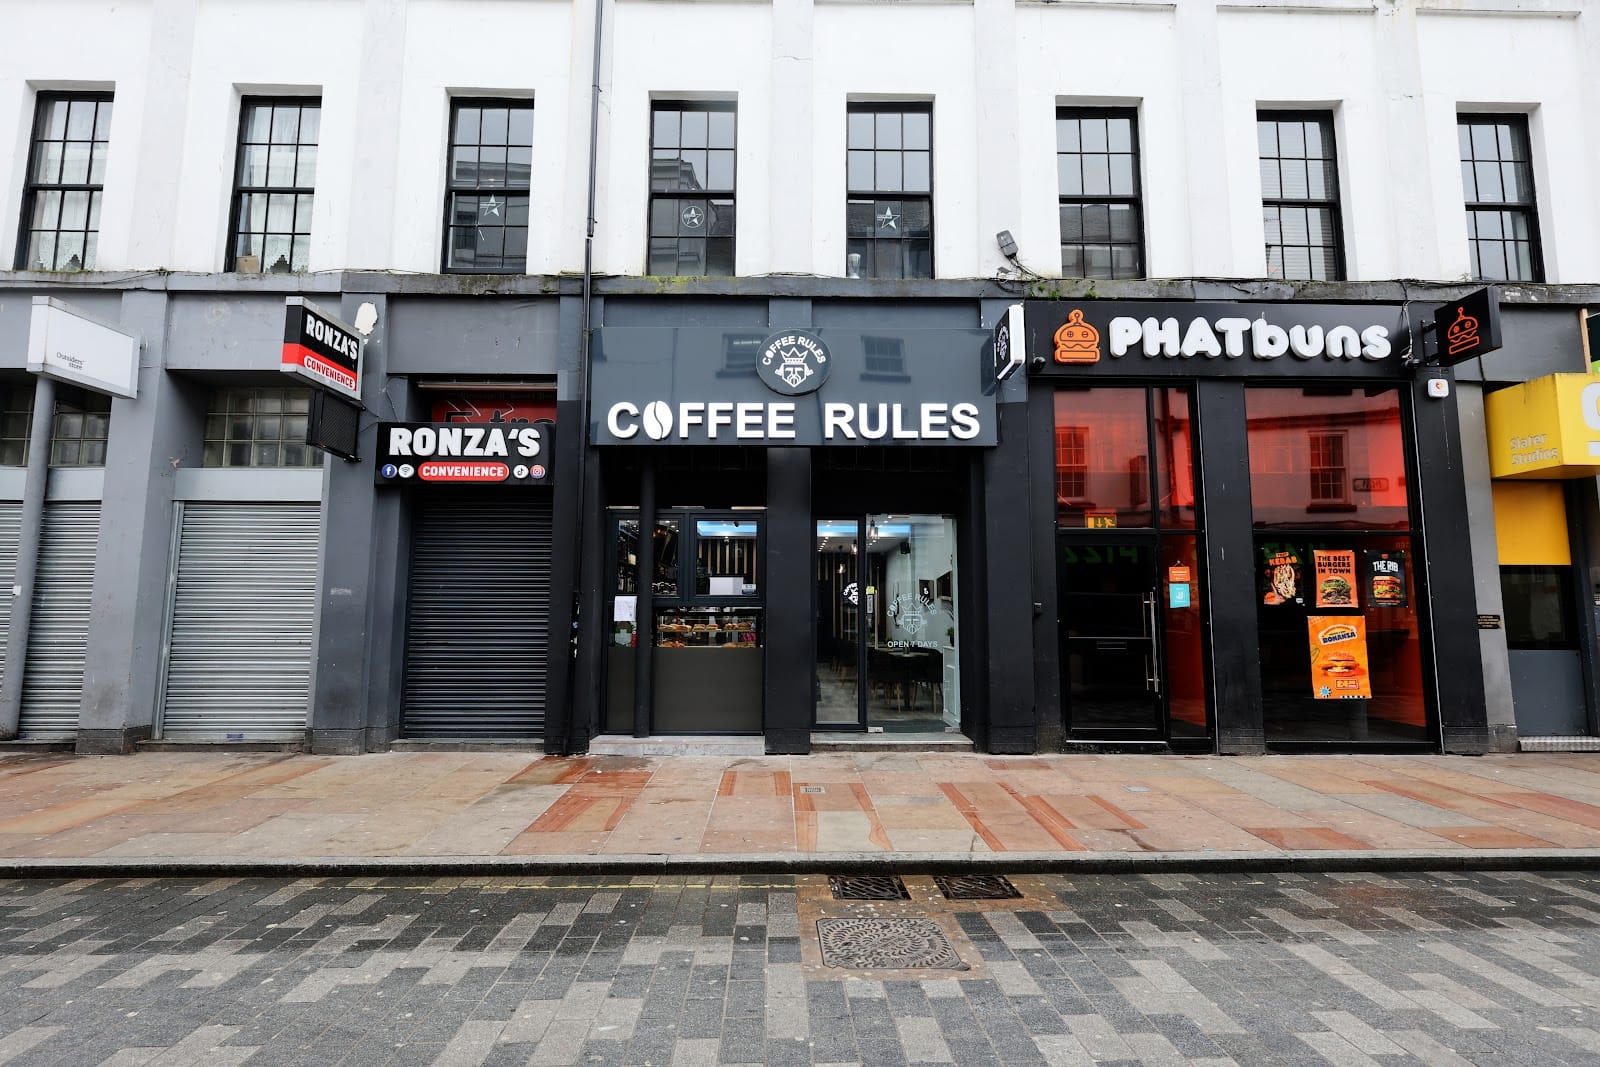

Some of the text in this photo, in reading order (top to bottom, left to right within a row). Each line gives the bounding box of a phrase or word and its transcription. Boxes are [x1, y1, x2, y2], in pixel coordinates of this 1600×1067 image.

[305, 314, 358, 360] RONZA'S
[762, 335, 827, 366] COFFEE RULES
[305, 357, 354, 388] CONVENIENCE
[607, 401, 980, 441] COFFEE RULES
[389, 427, 541, 457] RONZA'S
[1510, 433, 1547, 451] Slater
[1511, 449, 1558, 465] Studios
[422, 466, 504, 478] CONVENIENCE
[1372, 560, 1399, 571] THE RIB
[914, 593, 937, 616] RULES
[887, 640, 909, 648] OPEN
